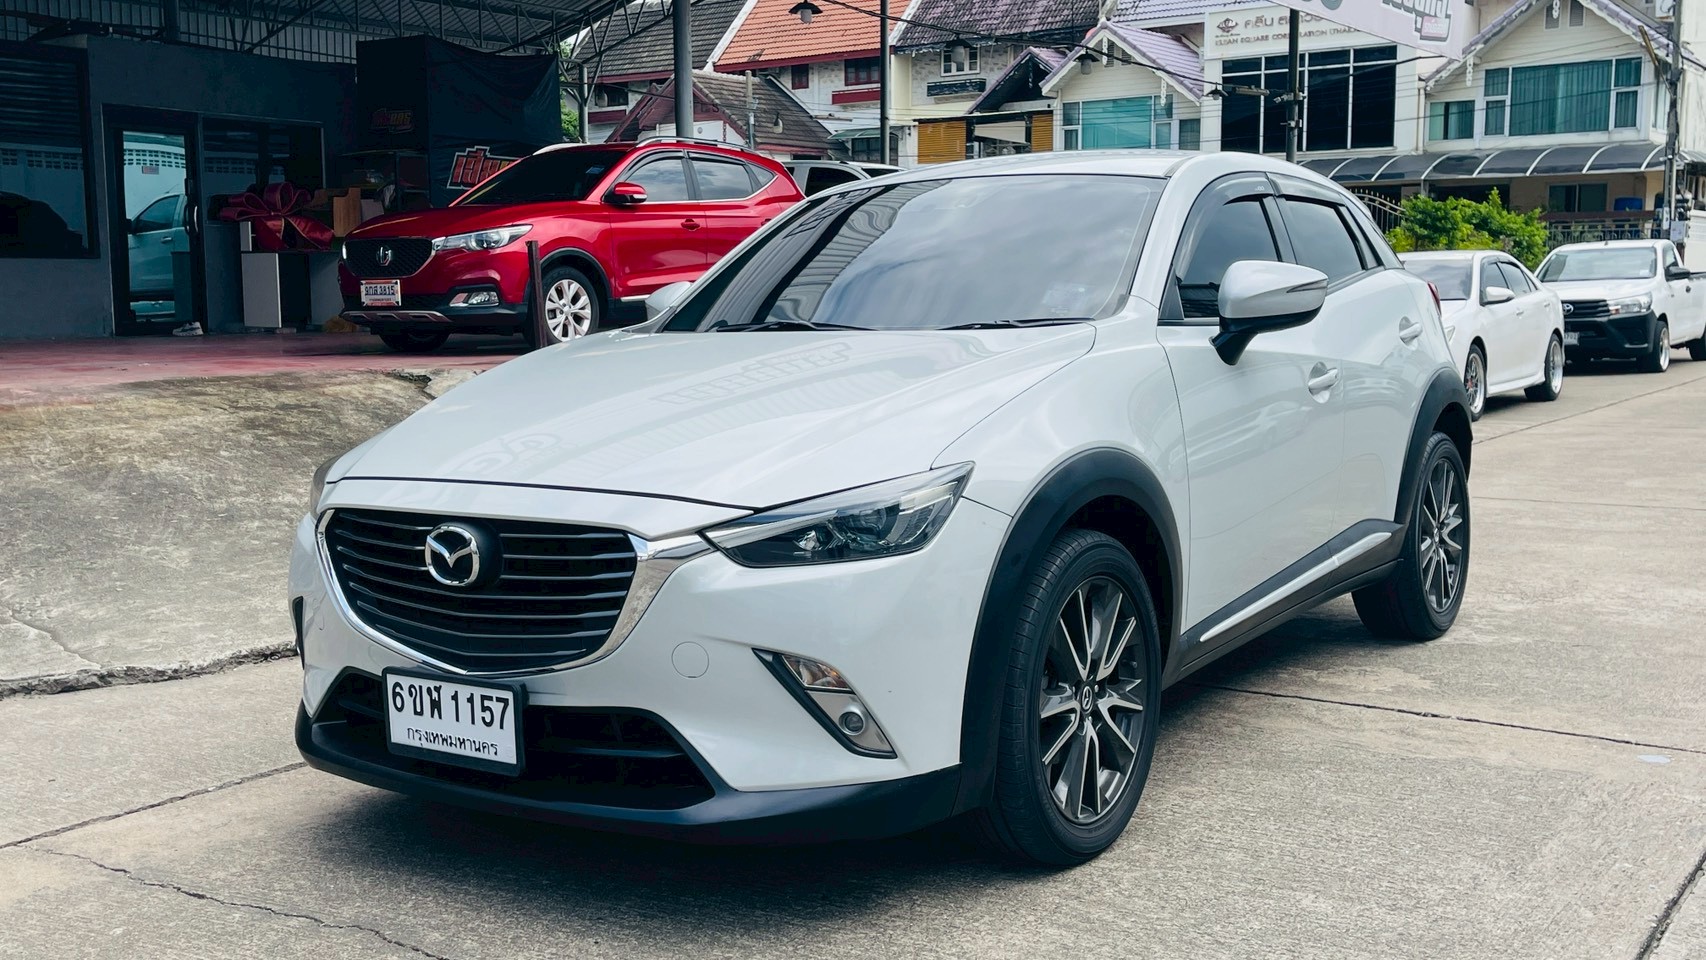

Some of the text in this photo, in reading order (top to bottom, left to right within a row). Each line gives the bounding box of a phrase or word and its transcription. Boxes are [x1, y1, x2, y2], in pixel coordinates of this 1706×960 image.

[451, 690, 510, 730] 1157
[406, 727, 499, 756] กรุงเทพมหานคร
